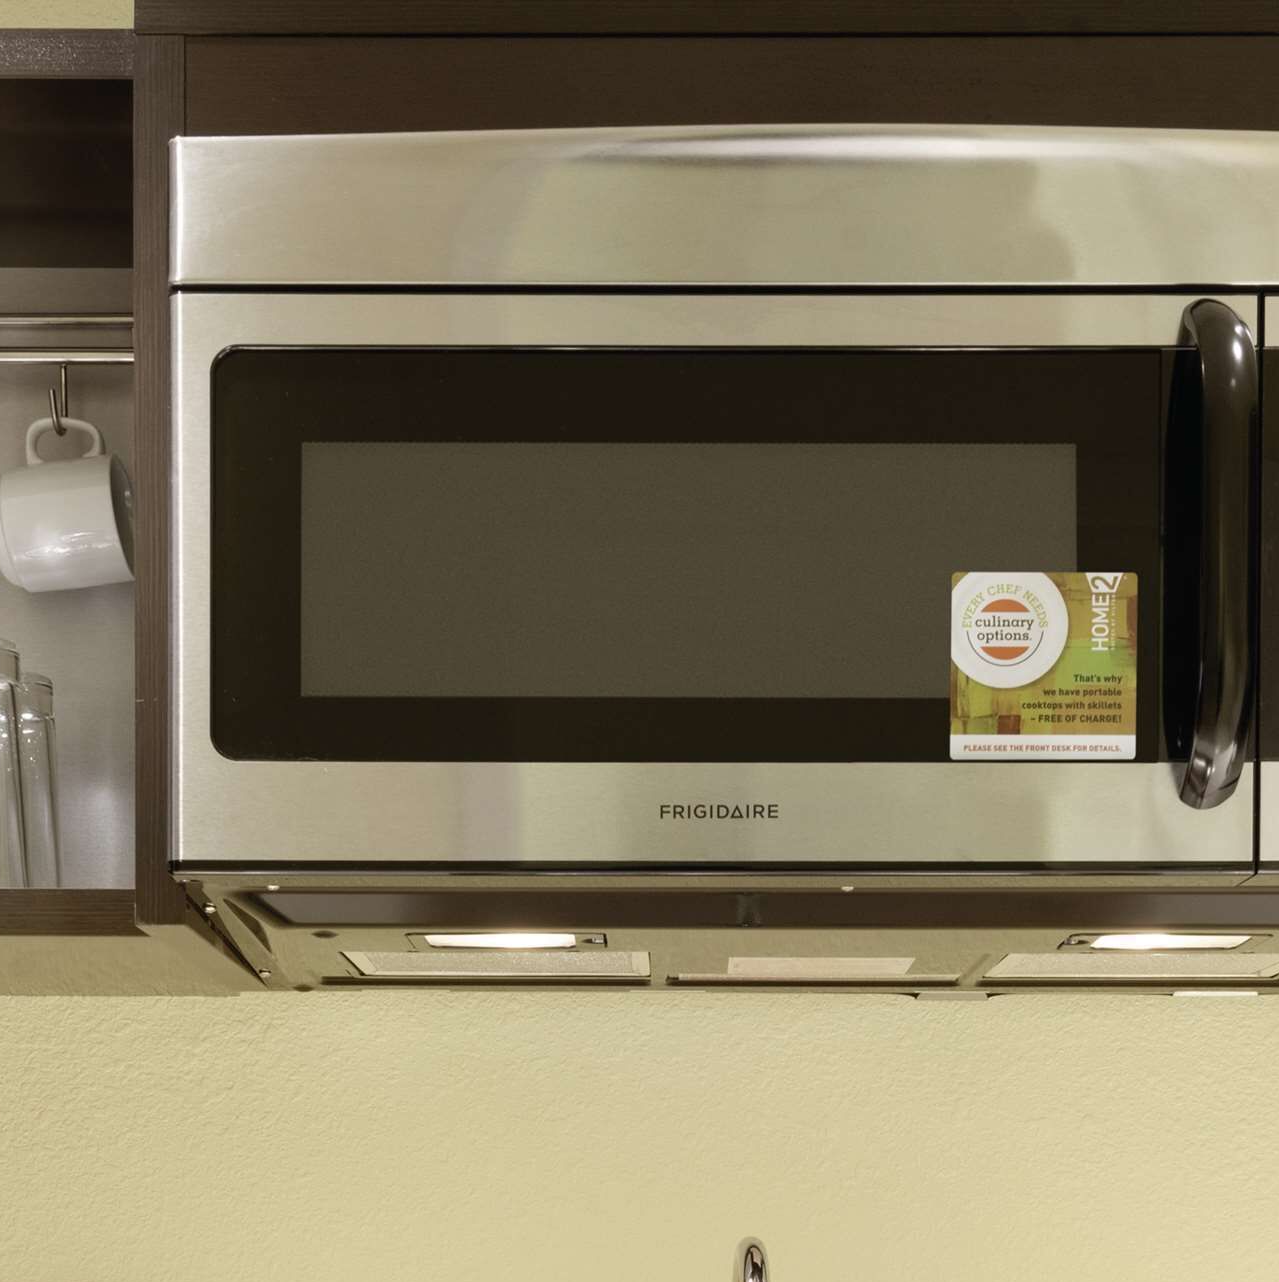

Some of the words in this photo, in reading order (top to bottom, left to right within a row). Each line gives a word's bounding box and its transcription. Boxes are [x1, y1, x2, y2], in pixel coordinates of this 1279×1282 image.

[962, 591, 984, 628] EVERY
[987, 584, 1022, 595] CHEF
[1023, 590, 1048, 628] NEEDS
[975, 616, 1034, 630] culinary
[1073, 674, 1101, 682] That's
[1104, 674, 1122, 684] why
[1059, 688, 1080, 696] have
[1083, 688, 1122, 698] portable
[1022, 701, 1063, 710] cooktops
[1065, 701, 1085, 709] with
[1087, 701, 1122, 709] skillets
[1038, 715, 1063, 723] FREE
[1065, 715, 1077, 723] OF
[1079, 715, 1122, 723] CHARGE!
[660, 804, 779, 819] FRIGIDAIRE
